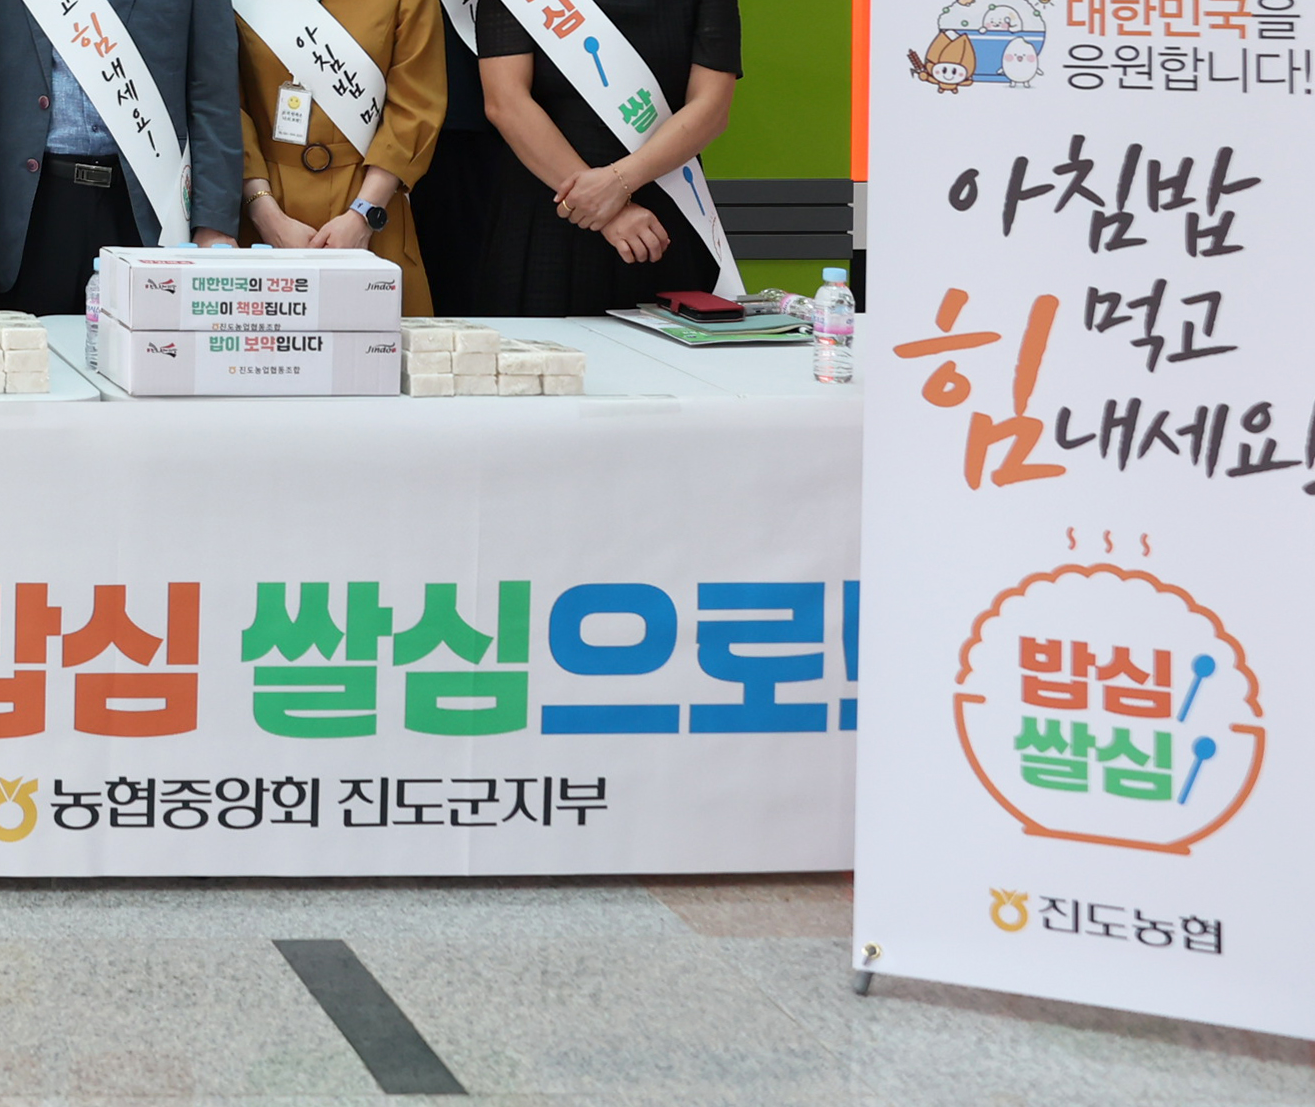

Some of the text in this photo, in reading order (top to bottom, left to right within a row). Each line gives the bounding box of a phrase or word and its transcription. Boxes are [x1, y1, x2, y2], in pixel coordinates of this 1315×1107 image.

[71, 12, 118, 60] 힘
[101, 57, 162, 158] 내세요!
[295, 25, 367, 101] 아침밥
[1063, 43, 1313, 94] 응원합니다!
[618, 87, 659, 134] 쌀
[948, 134, 1262, 257] 아침밥
[191, 300, 307, 317] 밥심이 책임집니다
[192, 276, 262, 293] 대한민국의
[266, 277, 309, 293] 건강은
[209, 335, 324, 353] 밥이 보약입니다
[1083, 278, 1239, 373] 먹고
[239, 365, 301, 375] 진도농업협동조합
[892, 287, 1067, 490] 힘
[1019, 636, 1173, 719] 밥심
[1013, 715, 1173, 801] 쌀심
[50, 775, 321, 831] 농협중앙회
[337, 776, 609, 828] 진도군지부
[1038, 894, 1224, 956] 진도농협
